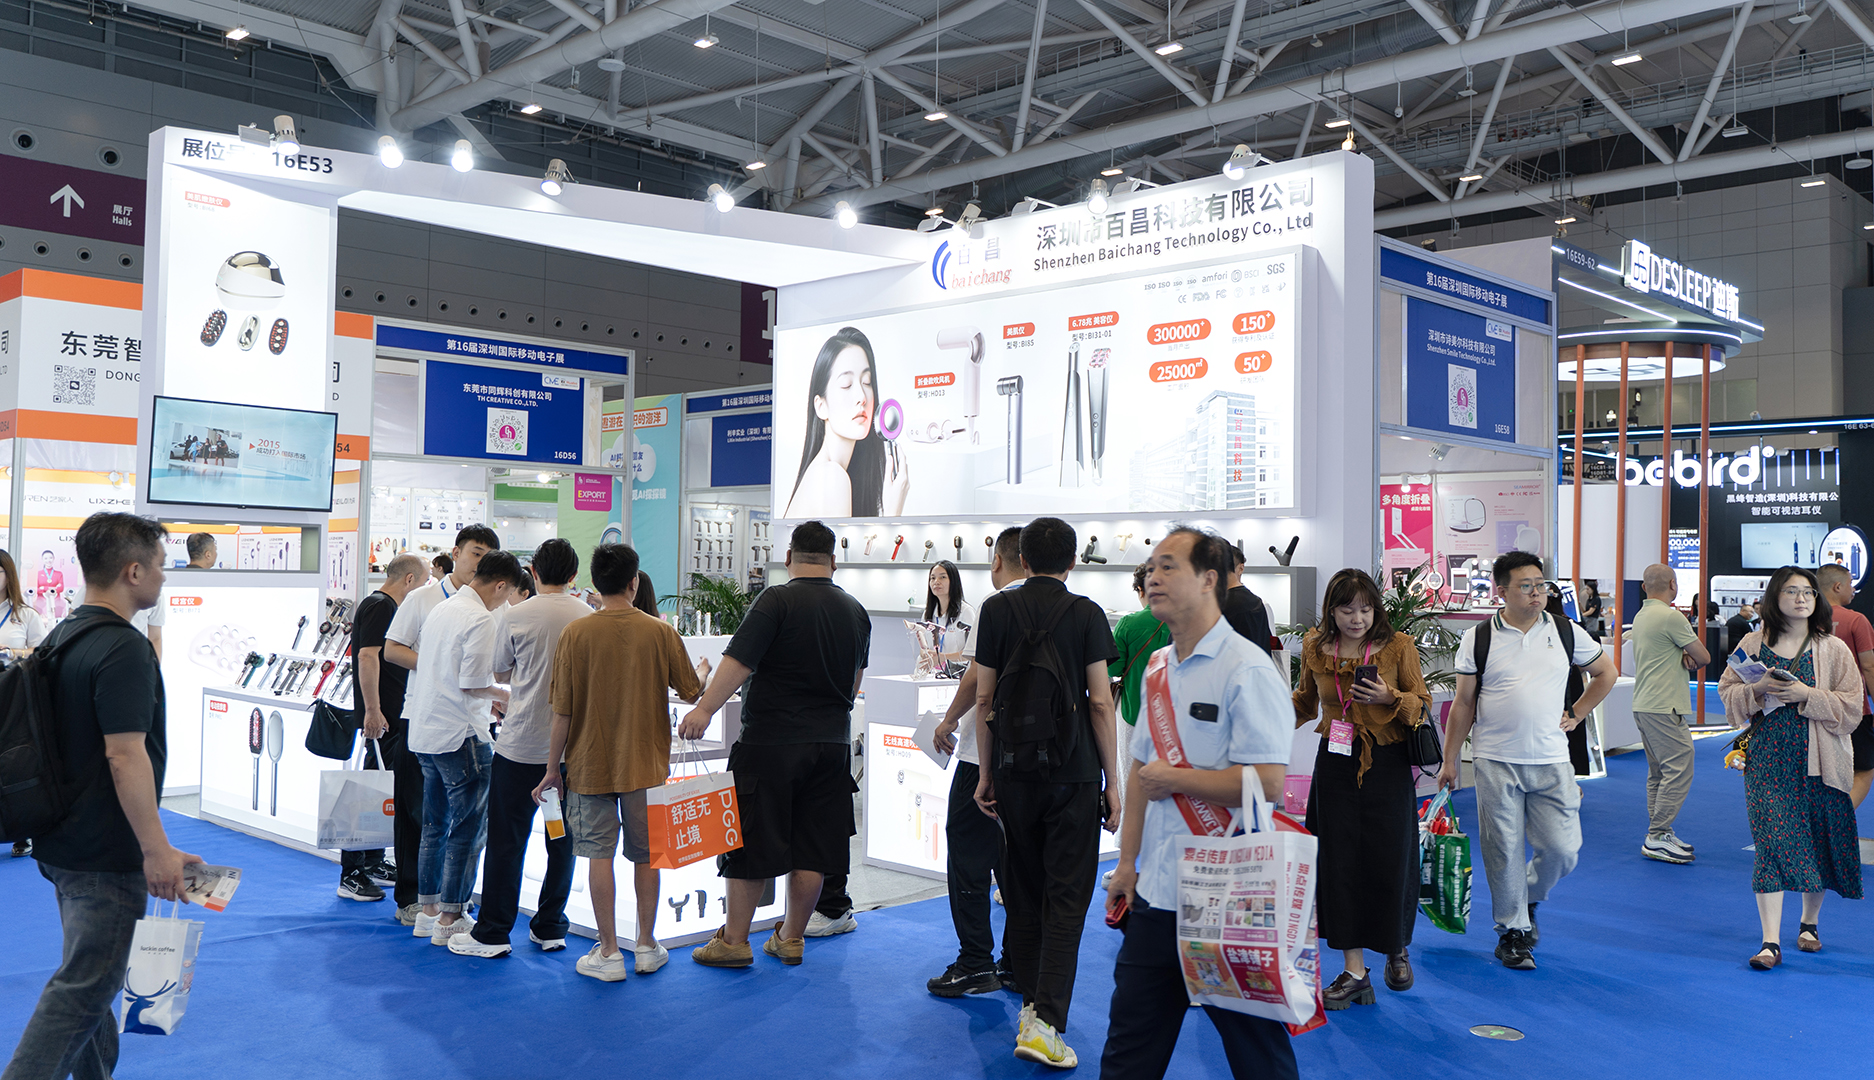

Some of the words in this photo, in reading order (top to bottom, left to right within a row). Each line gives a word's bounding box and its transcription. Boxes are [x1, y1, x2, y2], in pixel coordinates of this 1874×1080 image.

[272, 151, 333, 174] 16E53
[113, 205, 133, 216] 展厅
[1037, 177, 1314, 251] 深圳市百昌科技有限公司
[112, 215, 132, 227] Halls
[1034, 250, 1095, 271] Shenzhen
[1098, 240, 1161, 261] Baichang
[1165, 227, 1248, 249] Technology
[1252, 220, 1283, 236] Co.,
[1286, 212, 1313, 230] Ltd
[1566, 248, 1595, 271] 16E59-62
[952, 269, 1012, 289] baichang
[1202, 271, 1228, 283] amfori
[1244, 269, 1259, 279] BSCI
[1266, 262, 1285, 275] SGS
[1650, 253, 1712, 310] DESLEEP
[1426, 271, 1508, 309] 第16届深圳国际移动电子展
[1093, 315, 1114, 325] 美容仪
[1006, 326, 1025, 337] 美肌仪
[60, 330, 142, 362] 东莞智
[446, 339, 565, 364] 第16届深圳国际移动电子展
[1428, 329, 1496, 356] 深圳市诗美尔科技有限公司
[463, 383, 552, 401] 东莞市同辉科创有限公司
[486, 396, 513, 404] CREATIVE
[1495, 423, 1510, 435] 16E58
[256, 447, 307, 460] 成功打入国际市场
[257, 438, 281, 450] 2015
[1233, 419, 1242, 482] 百昌科技
[554, 451, 577, 460] 16D56
[578, 490, 606, 499] EXPORT
[1382, 494, 1430, 505] 多角度折叠
[1751, 505, 1822, 516] 智能可视洁耳仪
[171, 597, 195, 605] 暖宫仪
[885, 736, 919, 749] 无线高速吹
[670, 796, 711, 825] 舒适无
[718, 789, 738, 847] DGG
[676, 824, 702, 850] 止境
[1226, 947, 1274, 967] 盐津铺子
